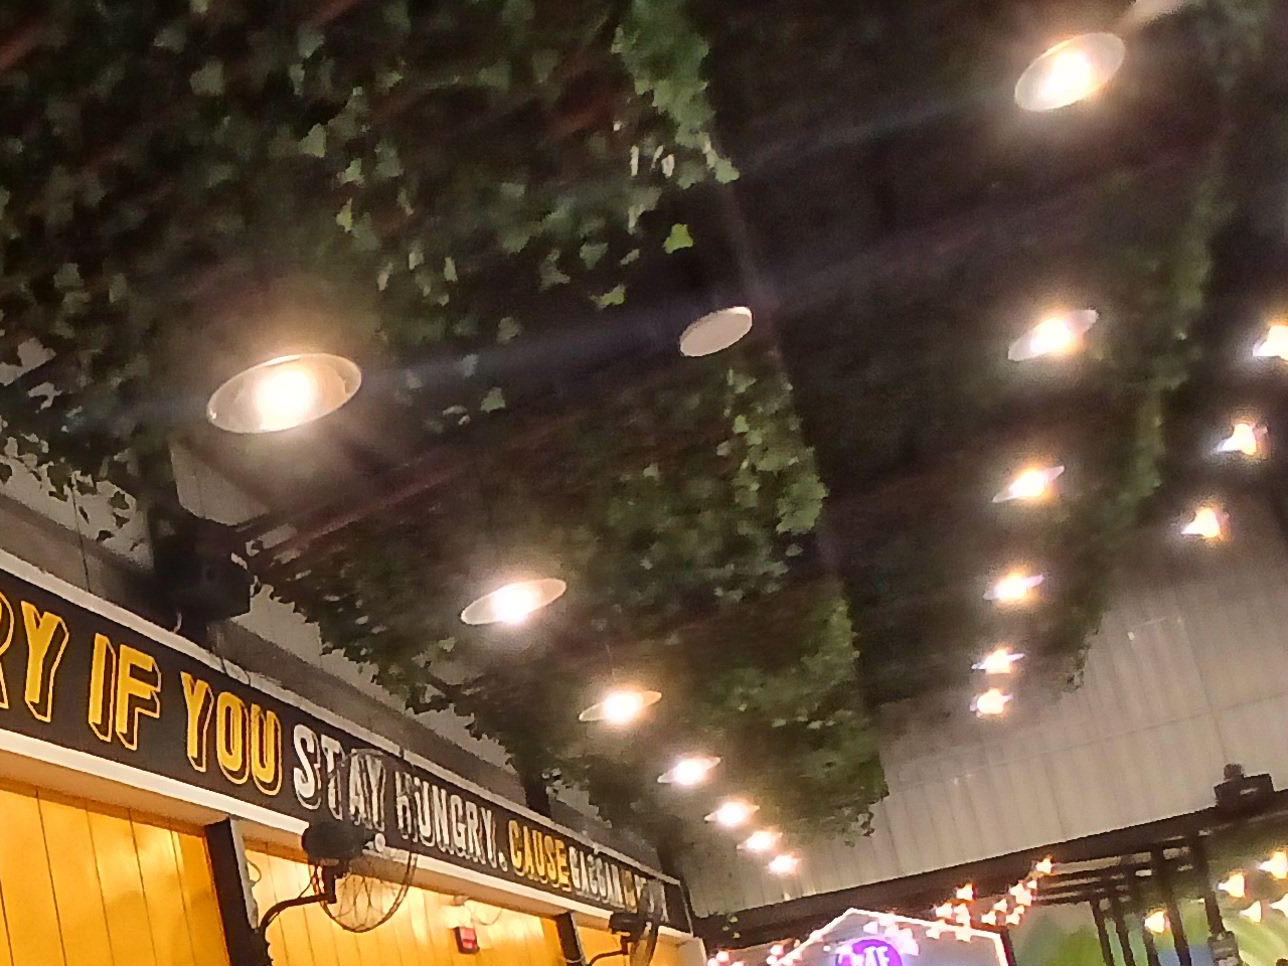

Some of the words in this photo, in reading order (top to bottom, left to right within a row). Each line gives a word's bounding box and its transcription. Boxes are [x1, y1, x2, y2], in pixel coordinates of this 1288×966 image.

[86, 631, 161, 751] IF
[180, 670, 283, 796] YOU
[293, 723, 388, 833] STAY
[508, 819, 572, 893] CAUSE
